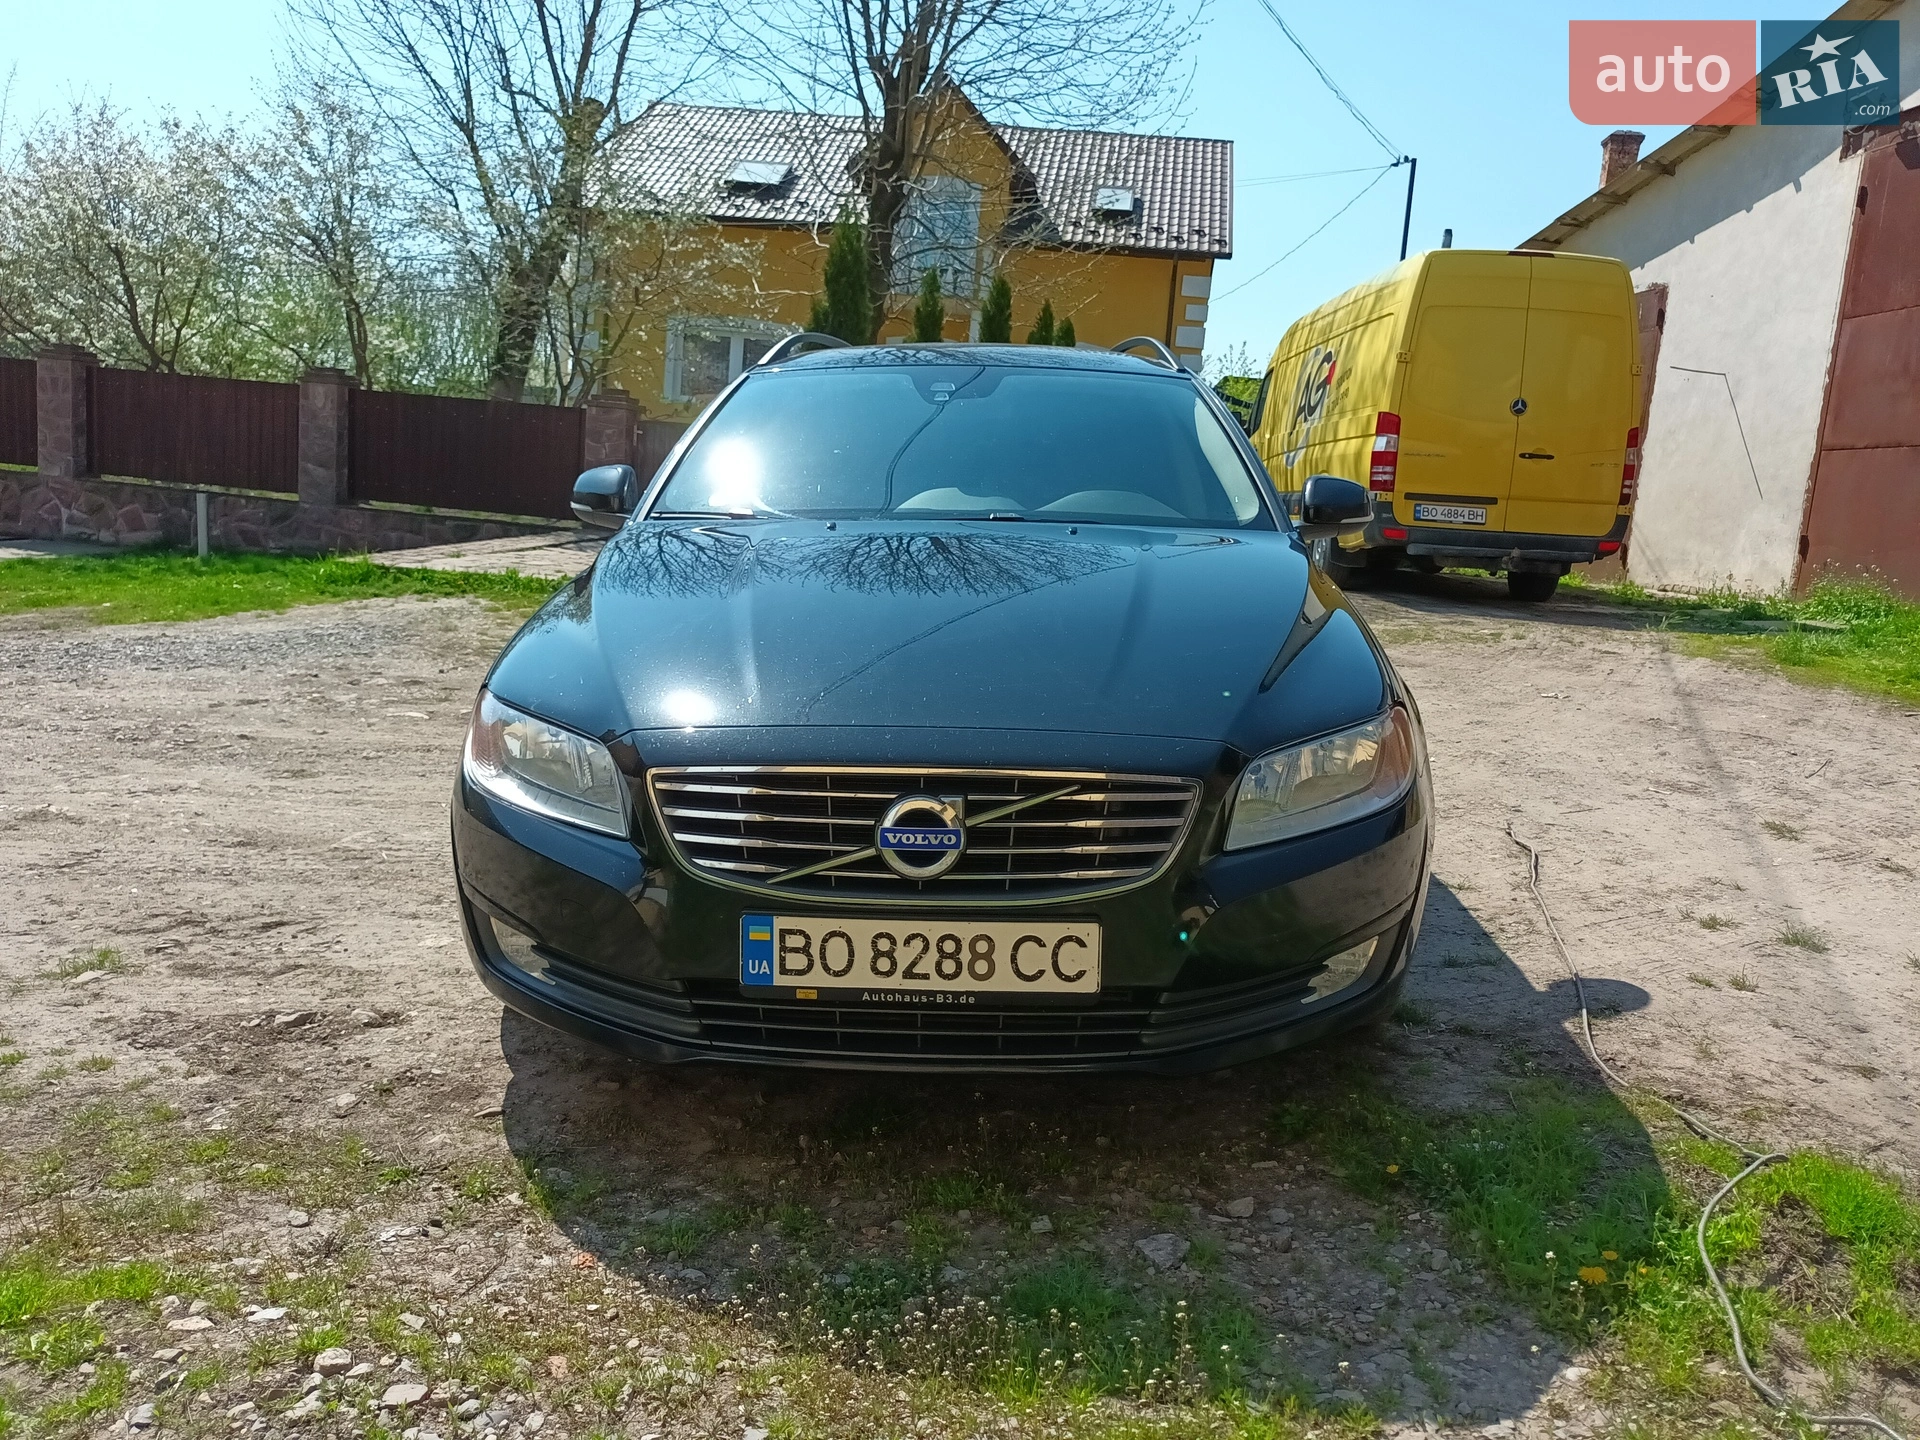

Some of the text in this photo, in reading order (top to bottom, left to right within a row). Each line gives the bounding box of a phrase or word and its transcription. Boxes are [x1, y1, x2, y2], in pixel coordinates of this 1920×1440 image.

[1421, 507, 1484, 521] BO 4884 BH
[884, 832, 957, 845] VOLVO
[778, 928, 1088, 983] BO 8288 CC
[748, 959, 771, 975] UA
[862, 991, 976, 1004] Autohaus-B3.de
